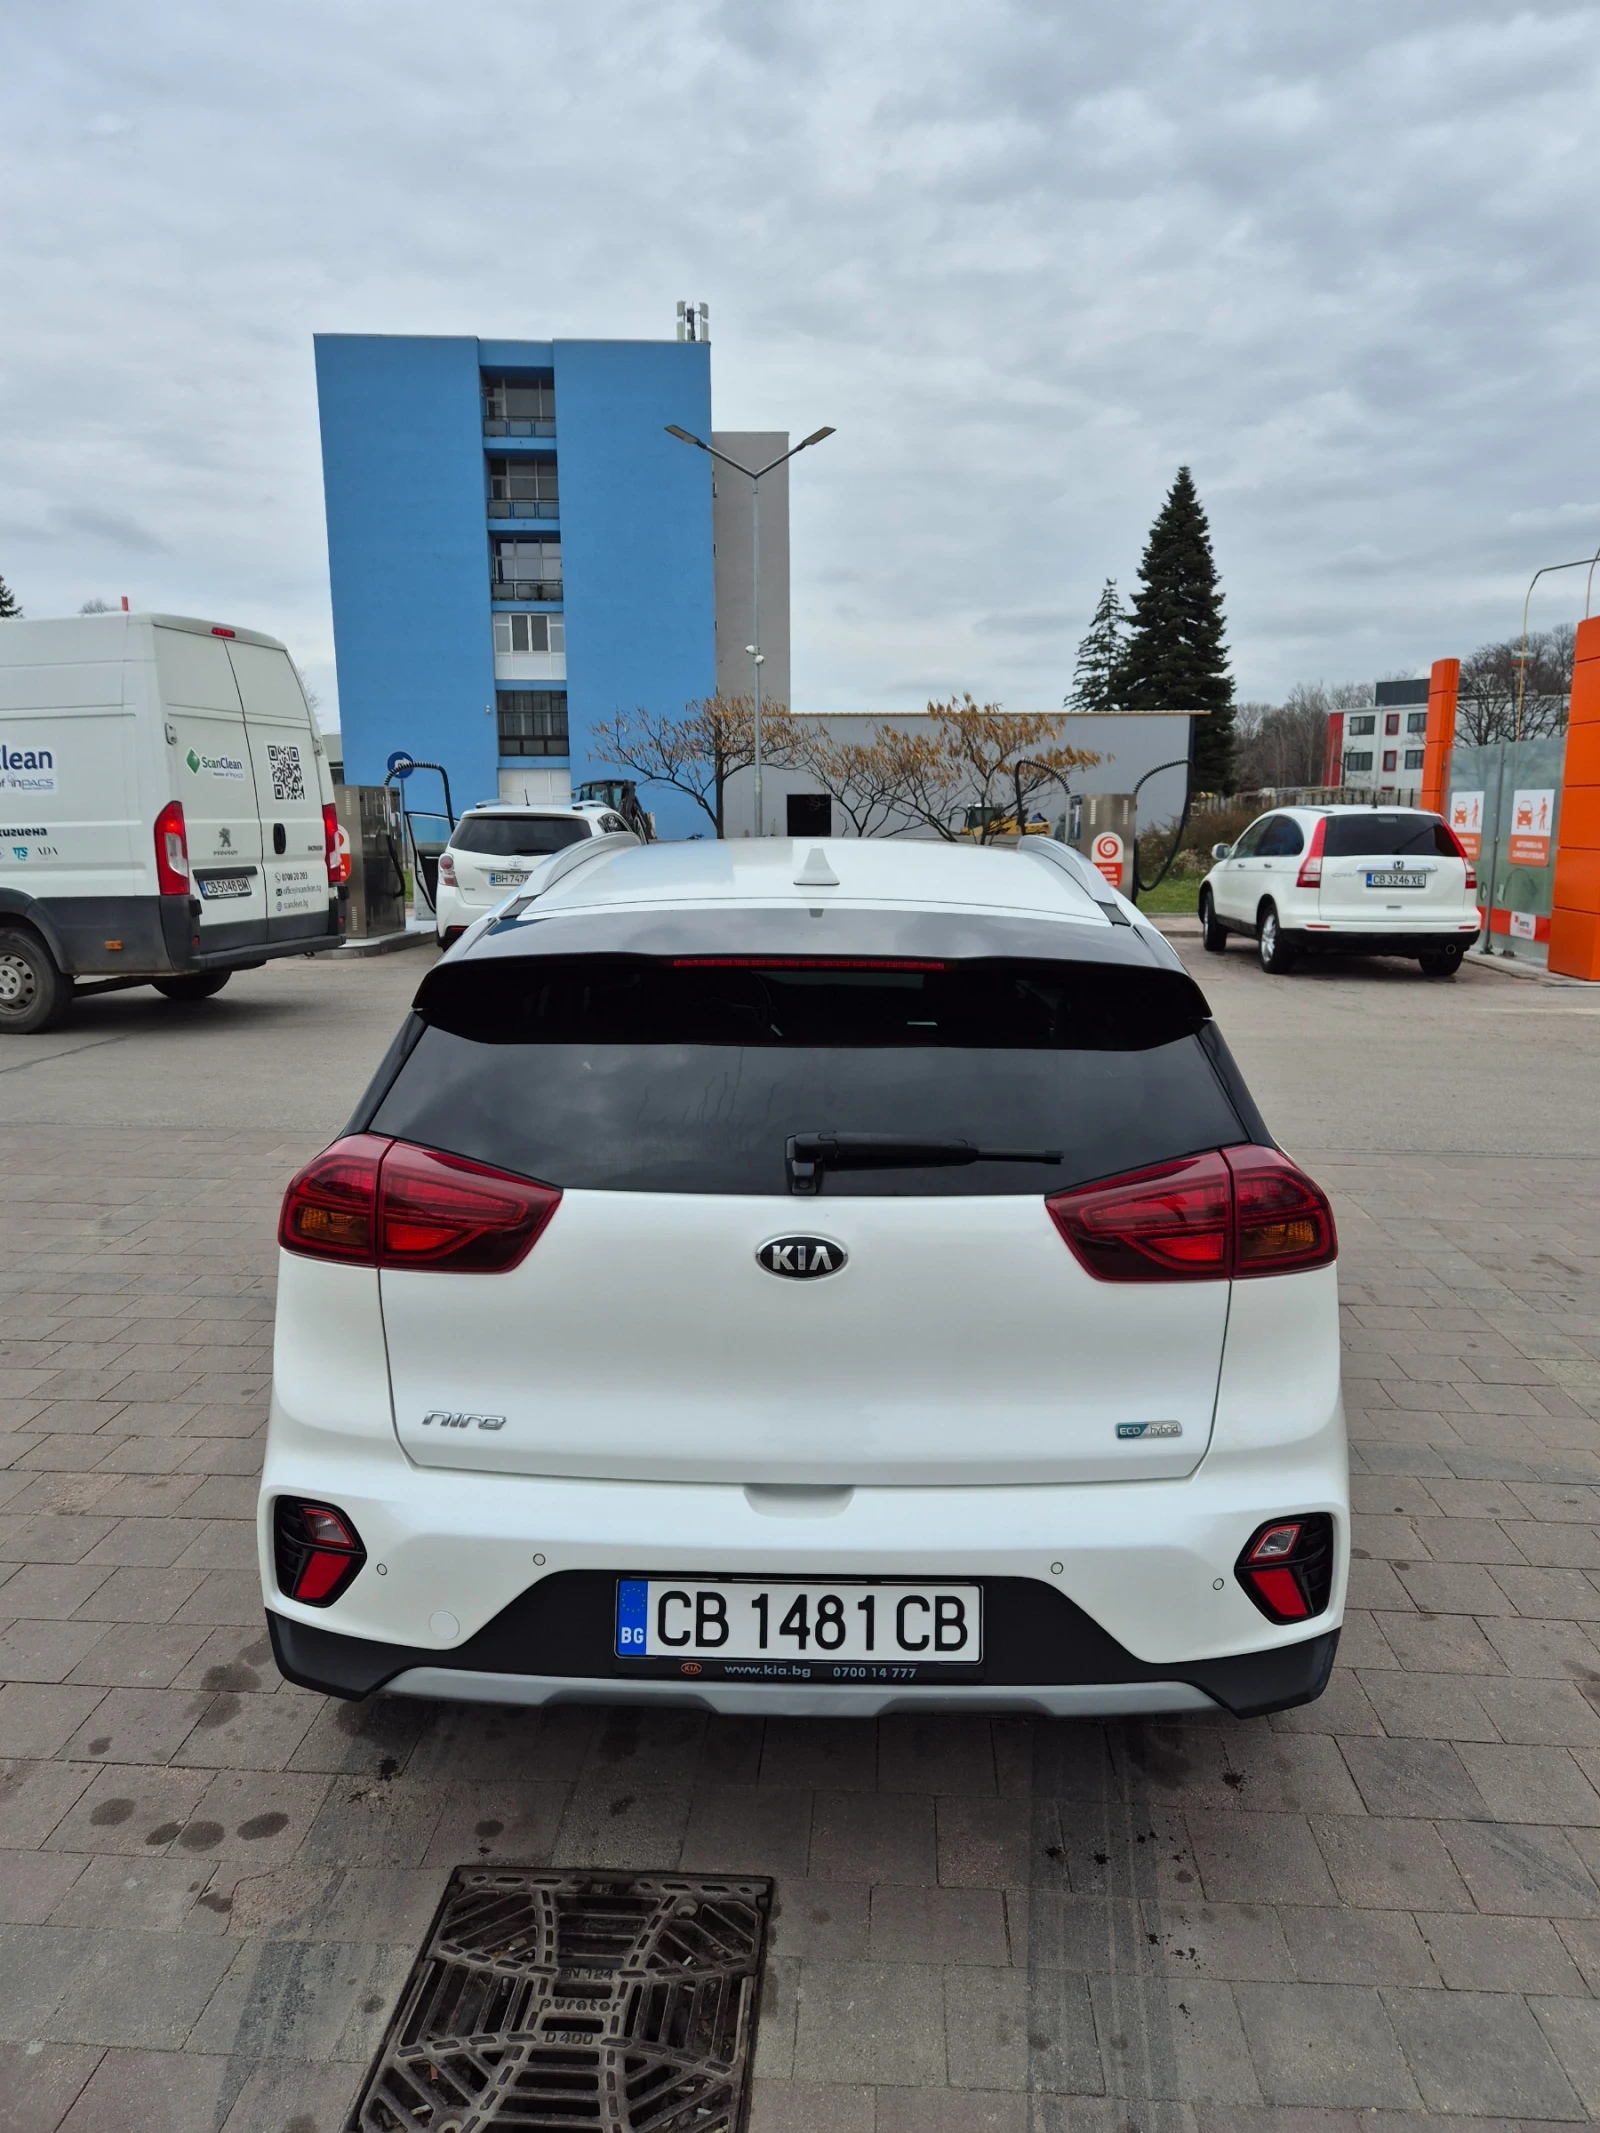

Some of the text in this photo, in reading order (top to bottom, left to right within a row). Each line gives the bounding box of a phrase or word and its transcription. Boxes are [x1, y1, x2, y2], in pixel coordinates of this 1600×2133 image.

[0, 745, 53, 771] lean
[201, 756, 243, 770] ScanClean
[206, 879, 249, 893] CB 5048 BM
[496, 875, 508, 883] BH
[1373, 875, 1423, 885] CB 3246 XE
[772, 1245, 833, 1270] KIA
[1120, 1424, 1179, 1436] ECO hybrid
[657, 1590, 968, 1652] CB 1481 CB
[621, 1627, 645, 1644] BG
[724, 1664, 811, 1679] www.kia.bg
[833, 1667, 917, 1679] 0700 14 777
[585, 1967, 614, 1980] 124
[538, 1998, 621, 2013] purator
[544, 2030, 594, 2046] D 400
